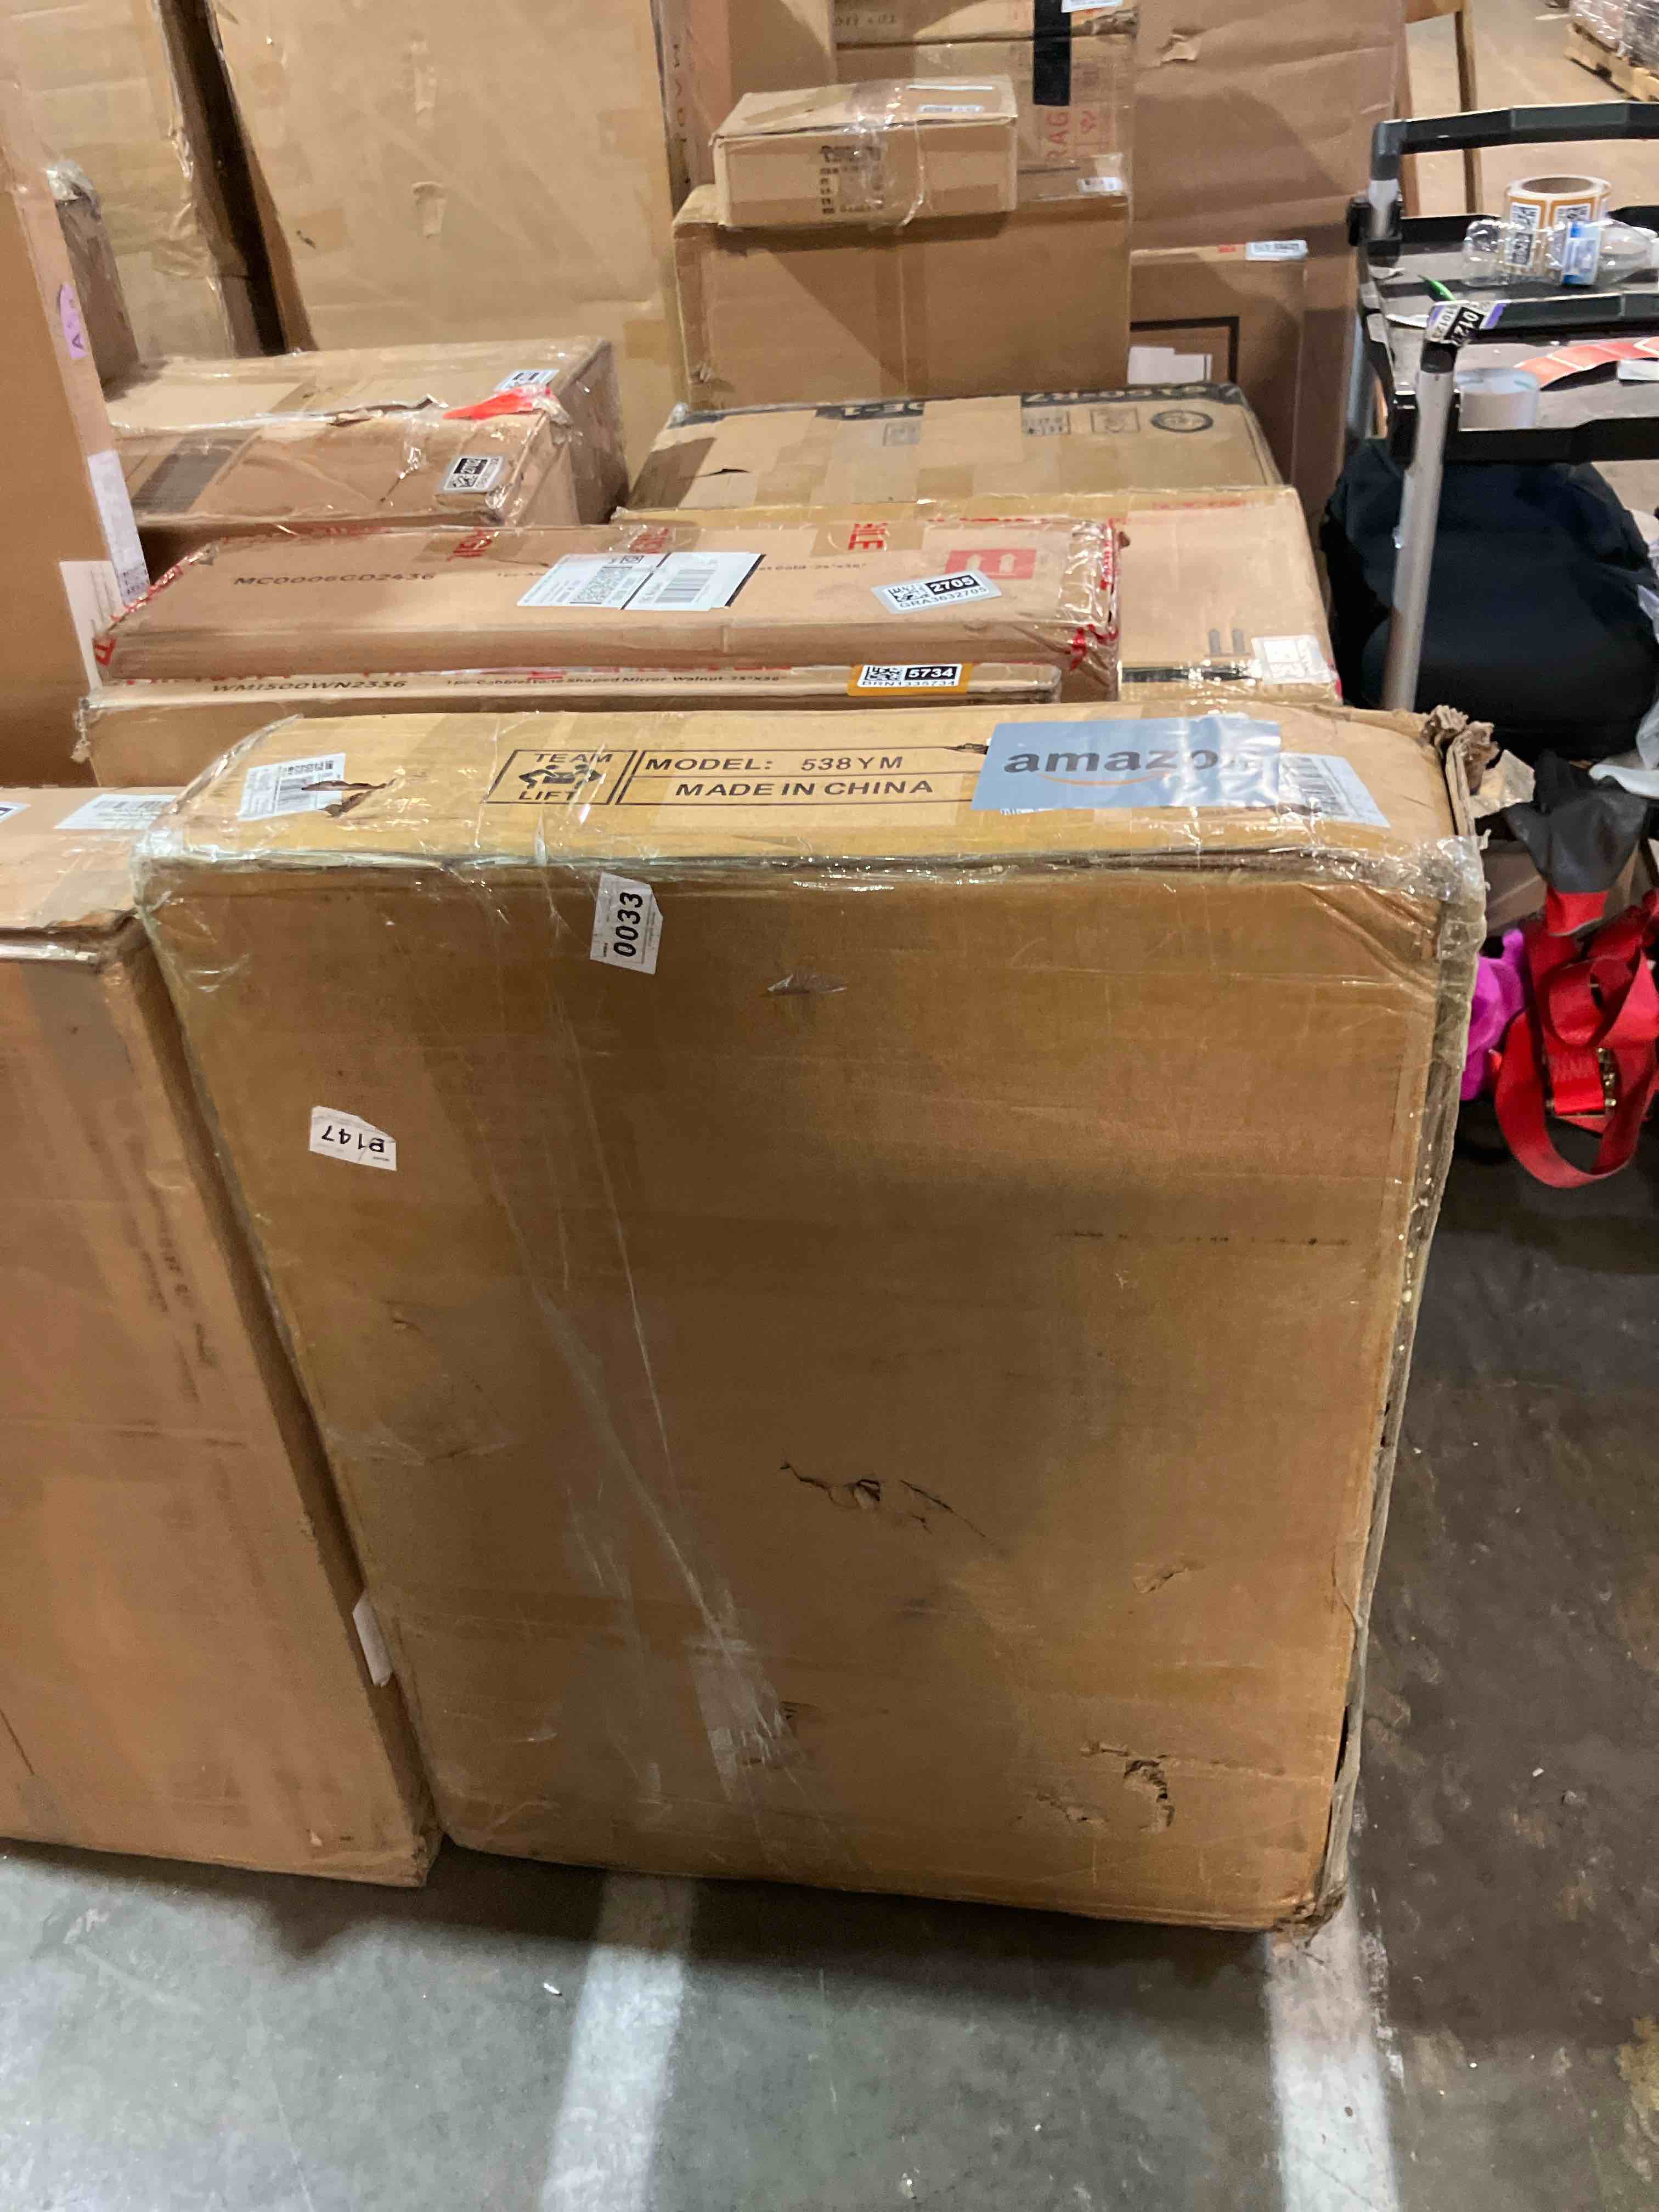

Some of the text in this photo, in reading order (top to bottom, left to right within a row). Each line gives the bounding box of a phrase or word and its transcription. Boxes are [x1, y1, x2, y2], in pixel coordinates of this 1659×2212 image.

[929, 577, 975, 592] 2705
[909, 668, 953, 678] 5734
[535, 753, 613, 763] TEAM
[645, 758, 773, 770] MODEL:
[1004, 749, 1249, 773] amazo
[675, 780, 933, 796] MADE IN CHINA
[518, 791, 577, 801] LIFT
[613, 892, 643, 957] 0033
